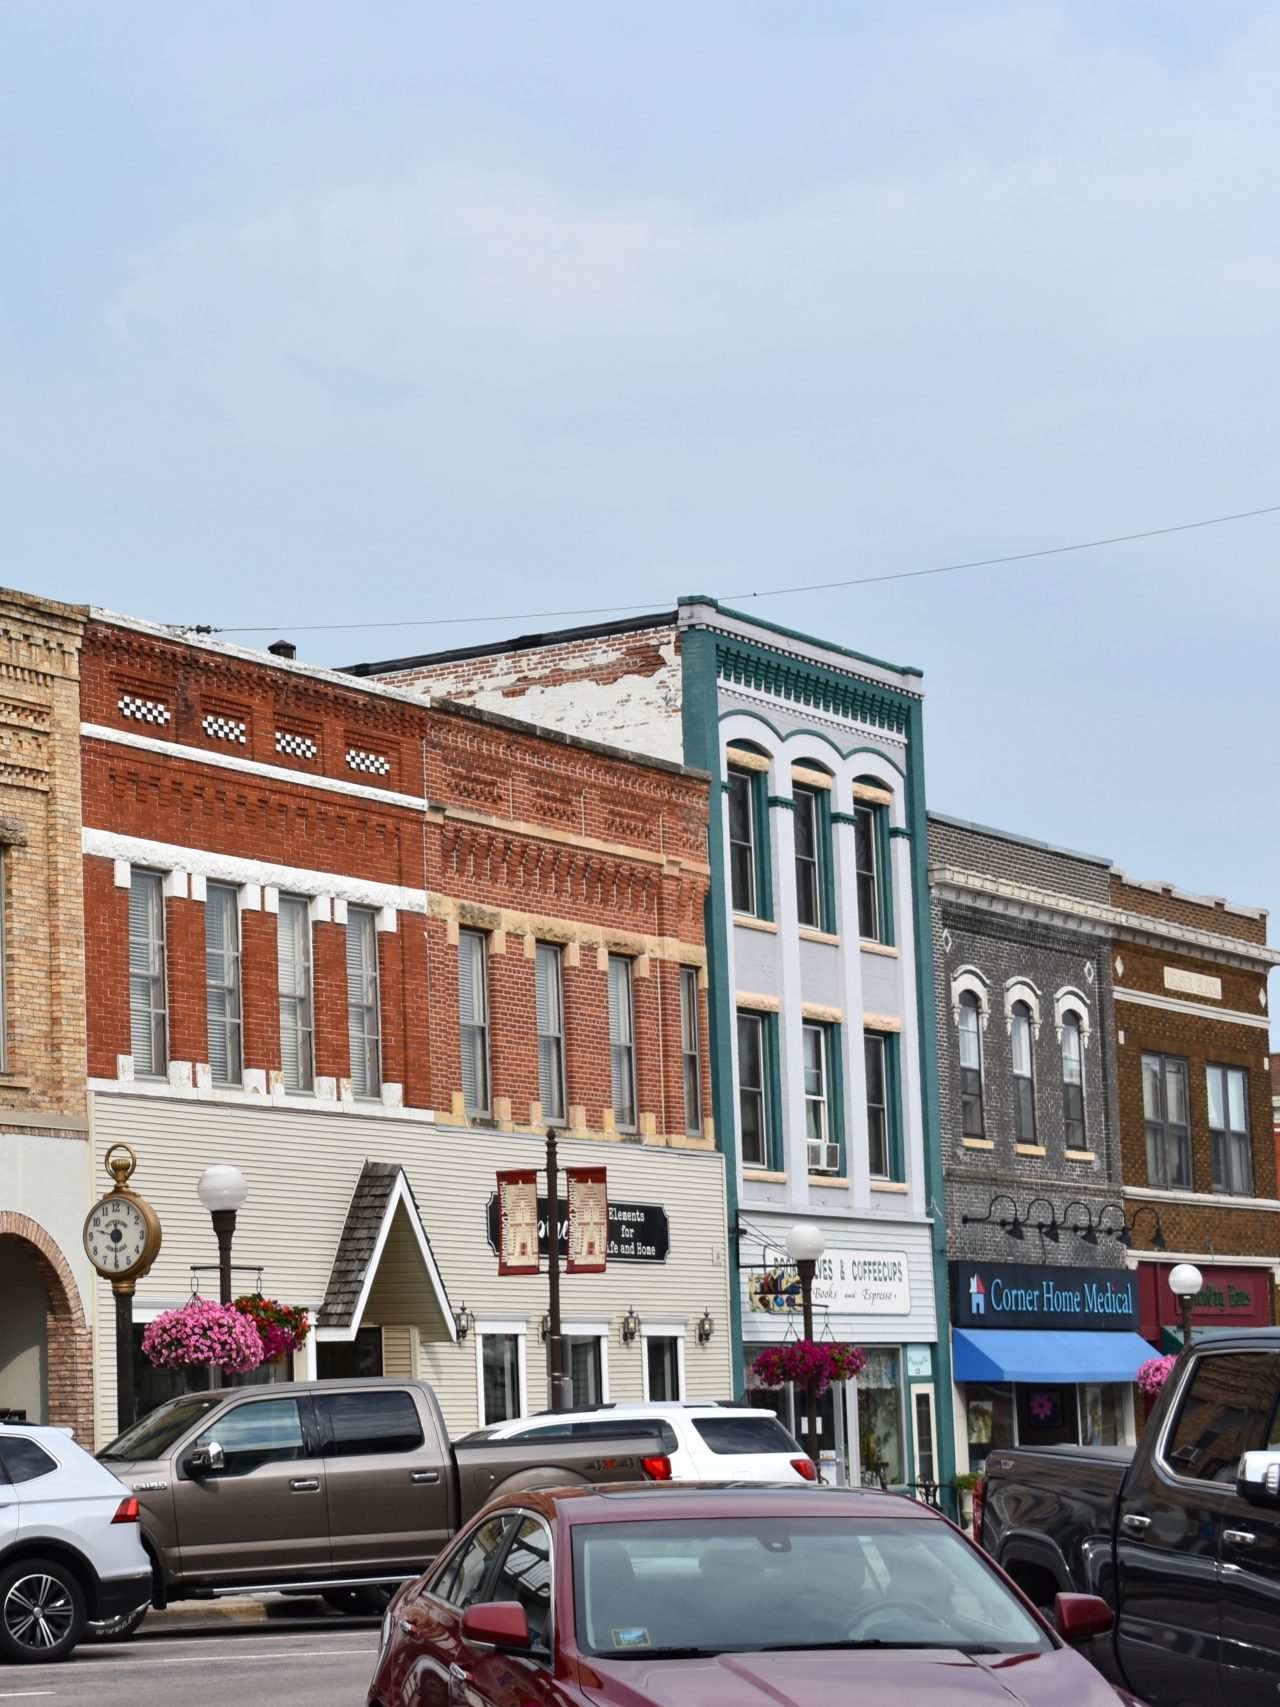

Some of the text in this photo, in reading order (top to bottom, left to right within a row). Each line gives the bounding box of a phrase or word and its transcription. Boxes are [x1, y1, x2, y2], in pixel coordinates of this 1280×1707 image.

[102, 1206, 108, 1216] 11
[112, 1202, 120, 1212] 12
[126, 1205, 130, 1215] 1
[608, 1207, 645, 1222] Elements
[93, 1217, 100, 1227] 10
[134, 1215, 140, 1225] 2
[88, 1231, 94, 1241] 9
[139, 1230, 145, 1240] 3
[621, 1224, 635, 1238] for
[93, 1246, 98, 1256] 8
[134, 1244, 139, 1254] 4
[620, 1241, 635, 1255] and
[636, 1242, 656, 1256] Home
[103, 1255, 107, 1265] 7
[114, 1259, 119, 1269] 6
[126, 1255, 131, 1266] 5
[840, 1259, 845, 1280] &
[851, 1260, 903, 1283] COFFEECUPS
[813, 1283, 892, 1306] Books and Espresso
[991, 1278, 1133, 1314] Corner Home Medical
